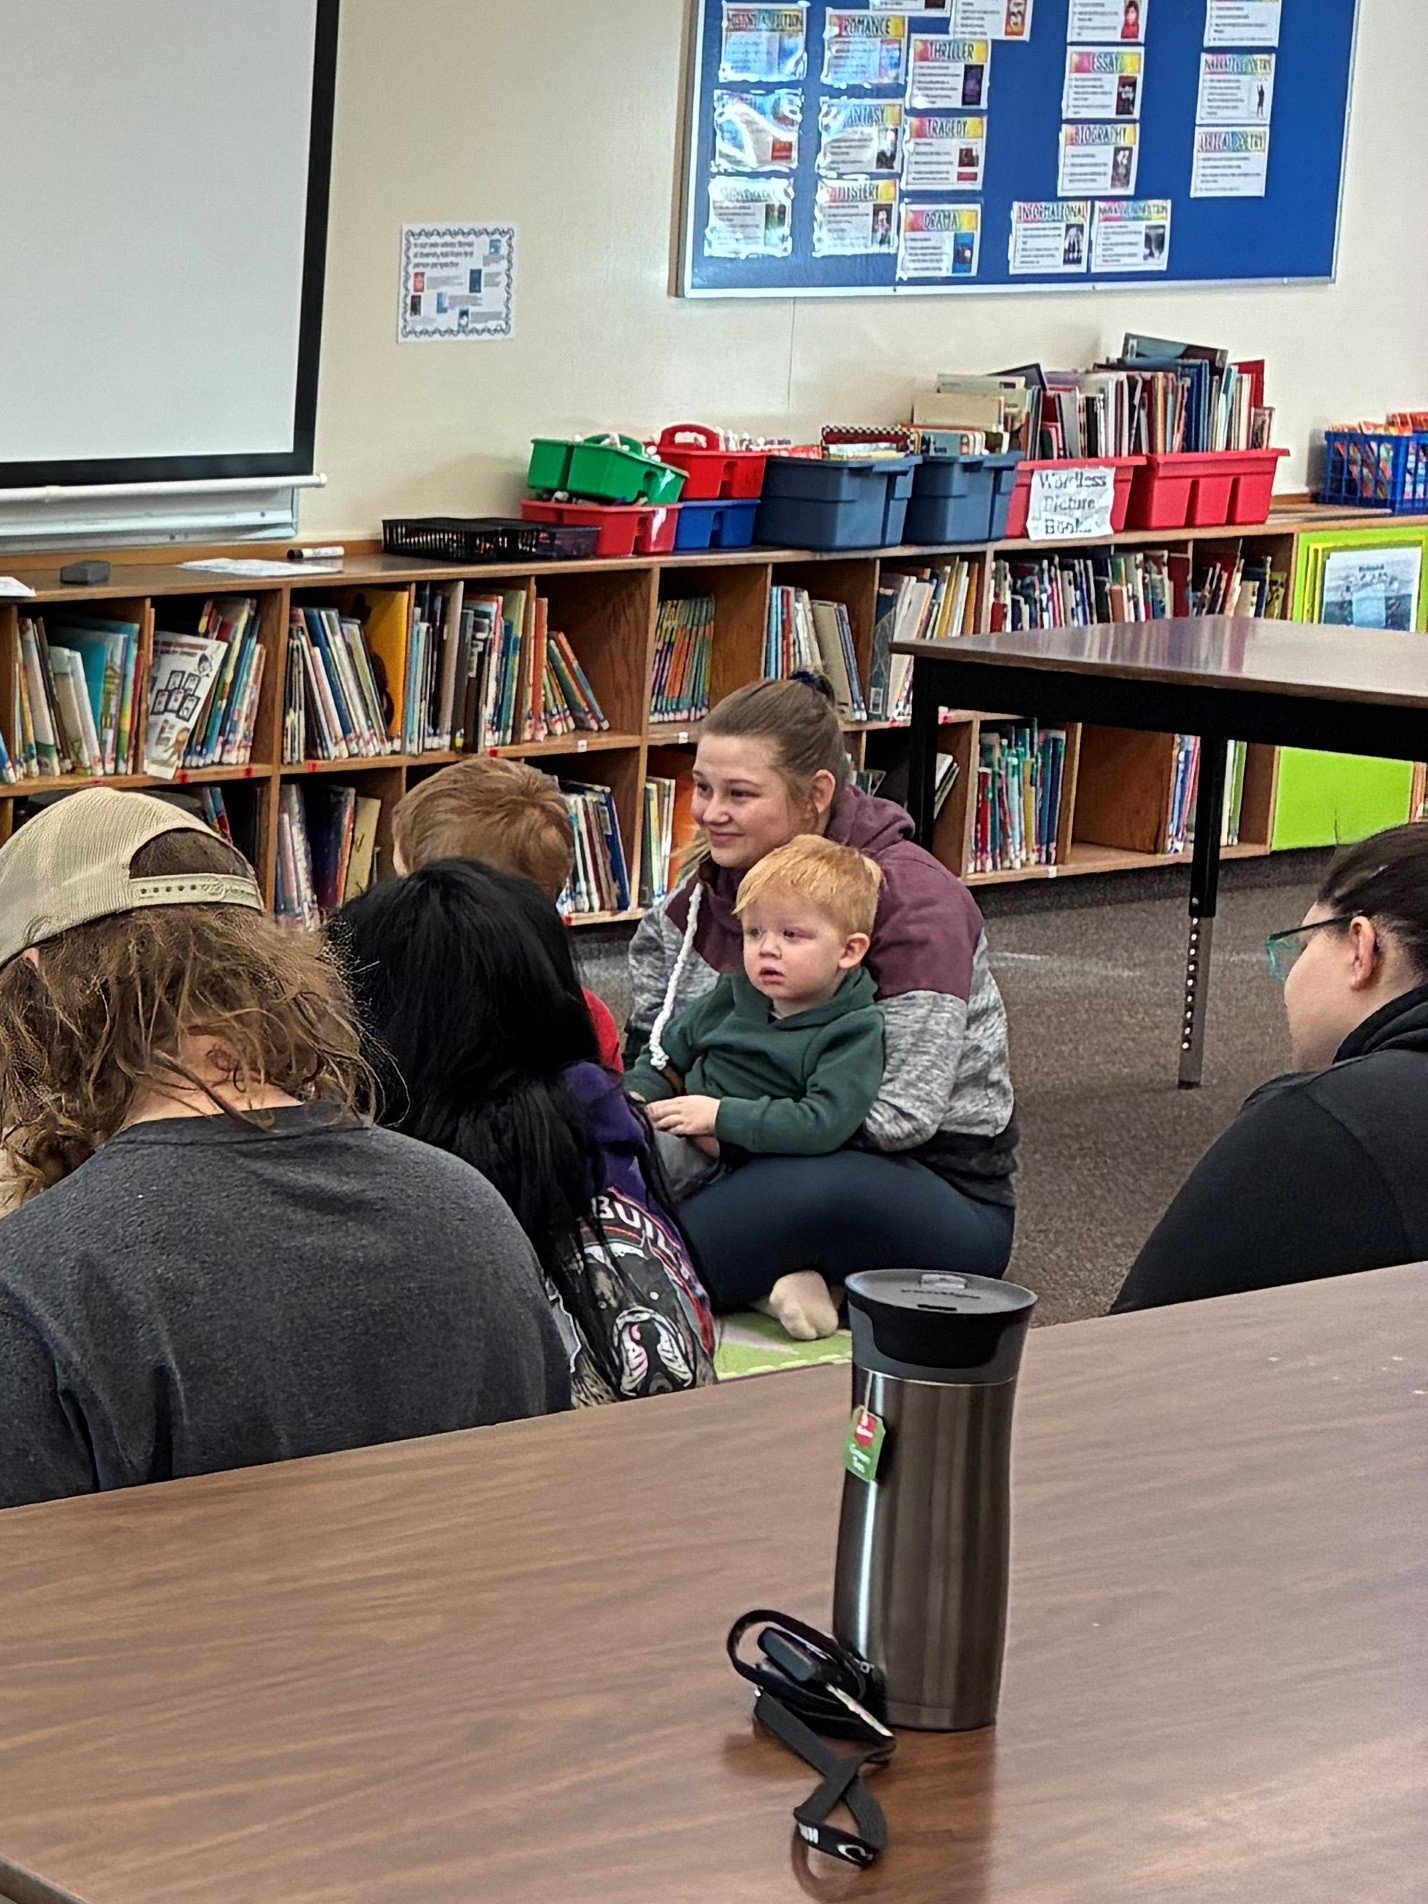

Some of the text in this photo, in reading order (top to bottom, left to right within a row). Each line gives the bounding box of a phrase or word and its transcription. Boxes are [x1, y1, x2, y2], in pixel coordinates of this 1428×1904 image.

[843, 15, 891, 37] ROMANCE
[929, 40, 975, 61] THRILLER
[1090, 51, 1121, 73] ESSAY
[927, 118, 968, 138] TRAGEDY
[1074, 126, 1128, 146] BIOGRAPHY
[924, 209, 961, 231] DRAMA
[1039, 470, 1107, 489] Wordless
[1044, 494, 1096, 512] Picture
